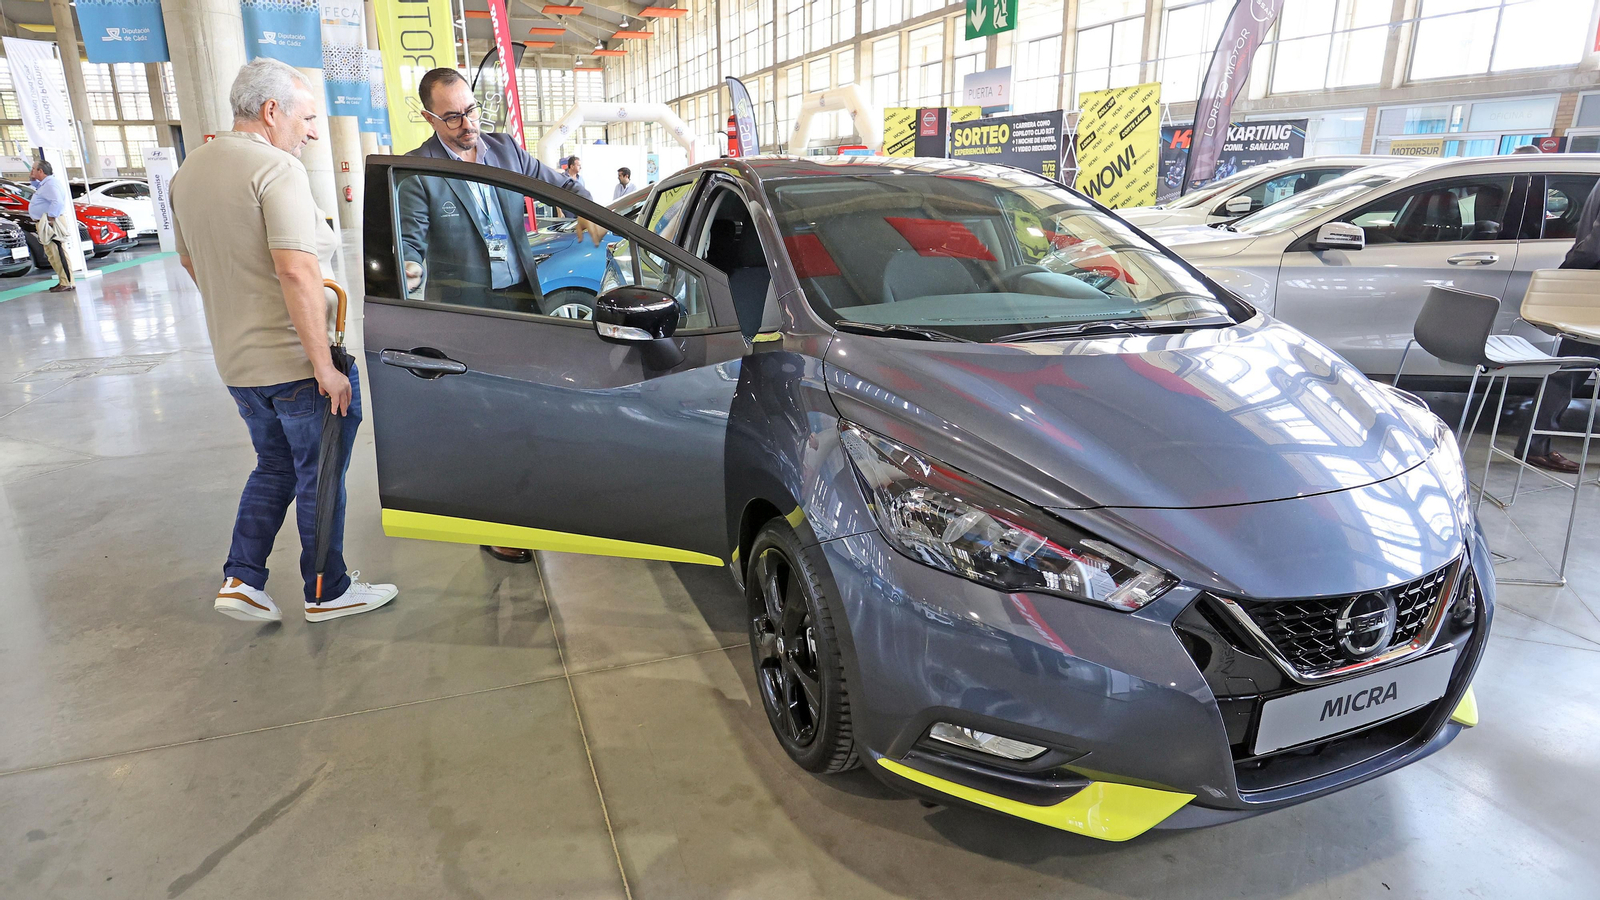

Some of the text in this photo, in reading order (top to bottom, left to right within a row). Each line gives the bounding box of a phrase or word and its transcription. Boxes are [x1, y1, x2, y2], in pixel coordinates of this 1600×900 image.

[968, 84, 1002, 100] PUERTA 2
[1204, 80, 1228, 137] LORETO
[1224, 28, 1250, 80] MOTOR
[954, 124, 1010, 147] SORTEO
[1226, 125, 1292, 142] KARTING
[954, 146, 1002, 156] EXPERIENCIA ÚNICA
[1249, 141, 1289, 151] SANLÚCAR
[1392, 146, 1439, 155] MOTORSUR
[1082, 144, 1136, 198] WOW!
[155, 174, 164, 200] Promise
[159, 202, 169, 230] Hyundai
[1320, 681, 1397, 722] MICRA
